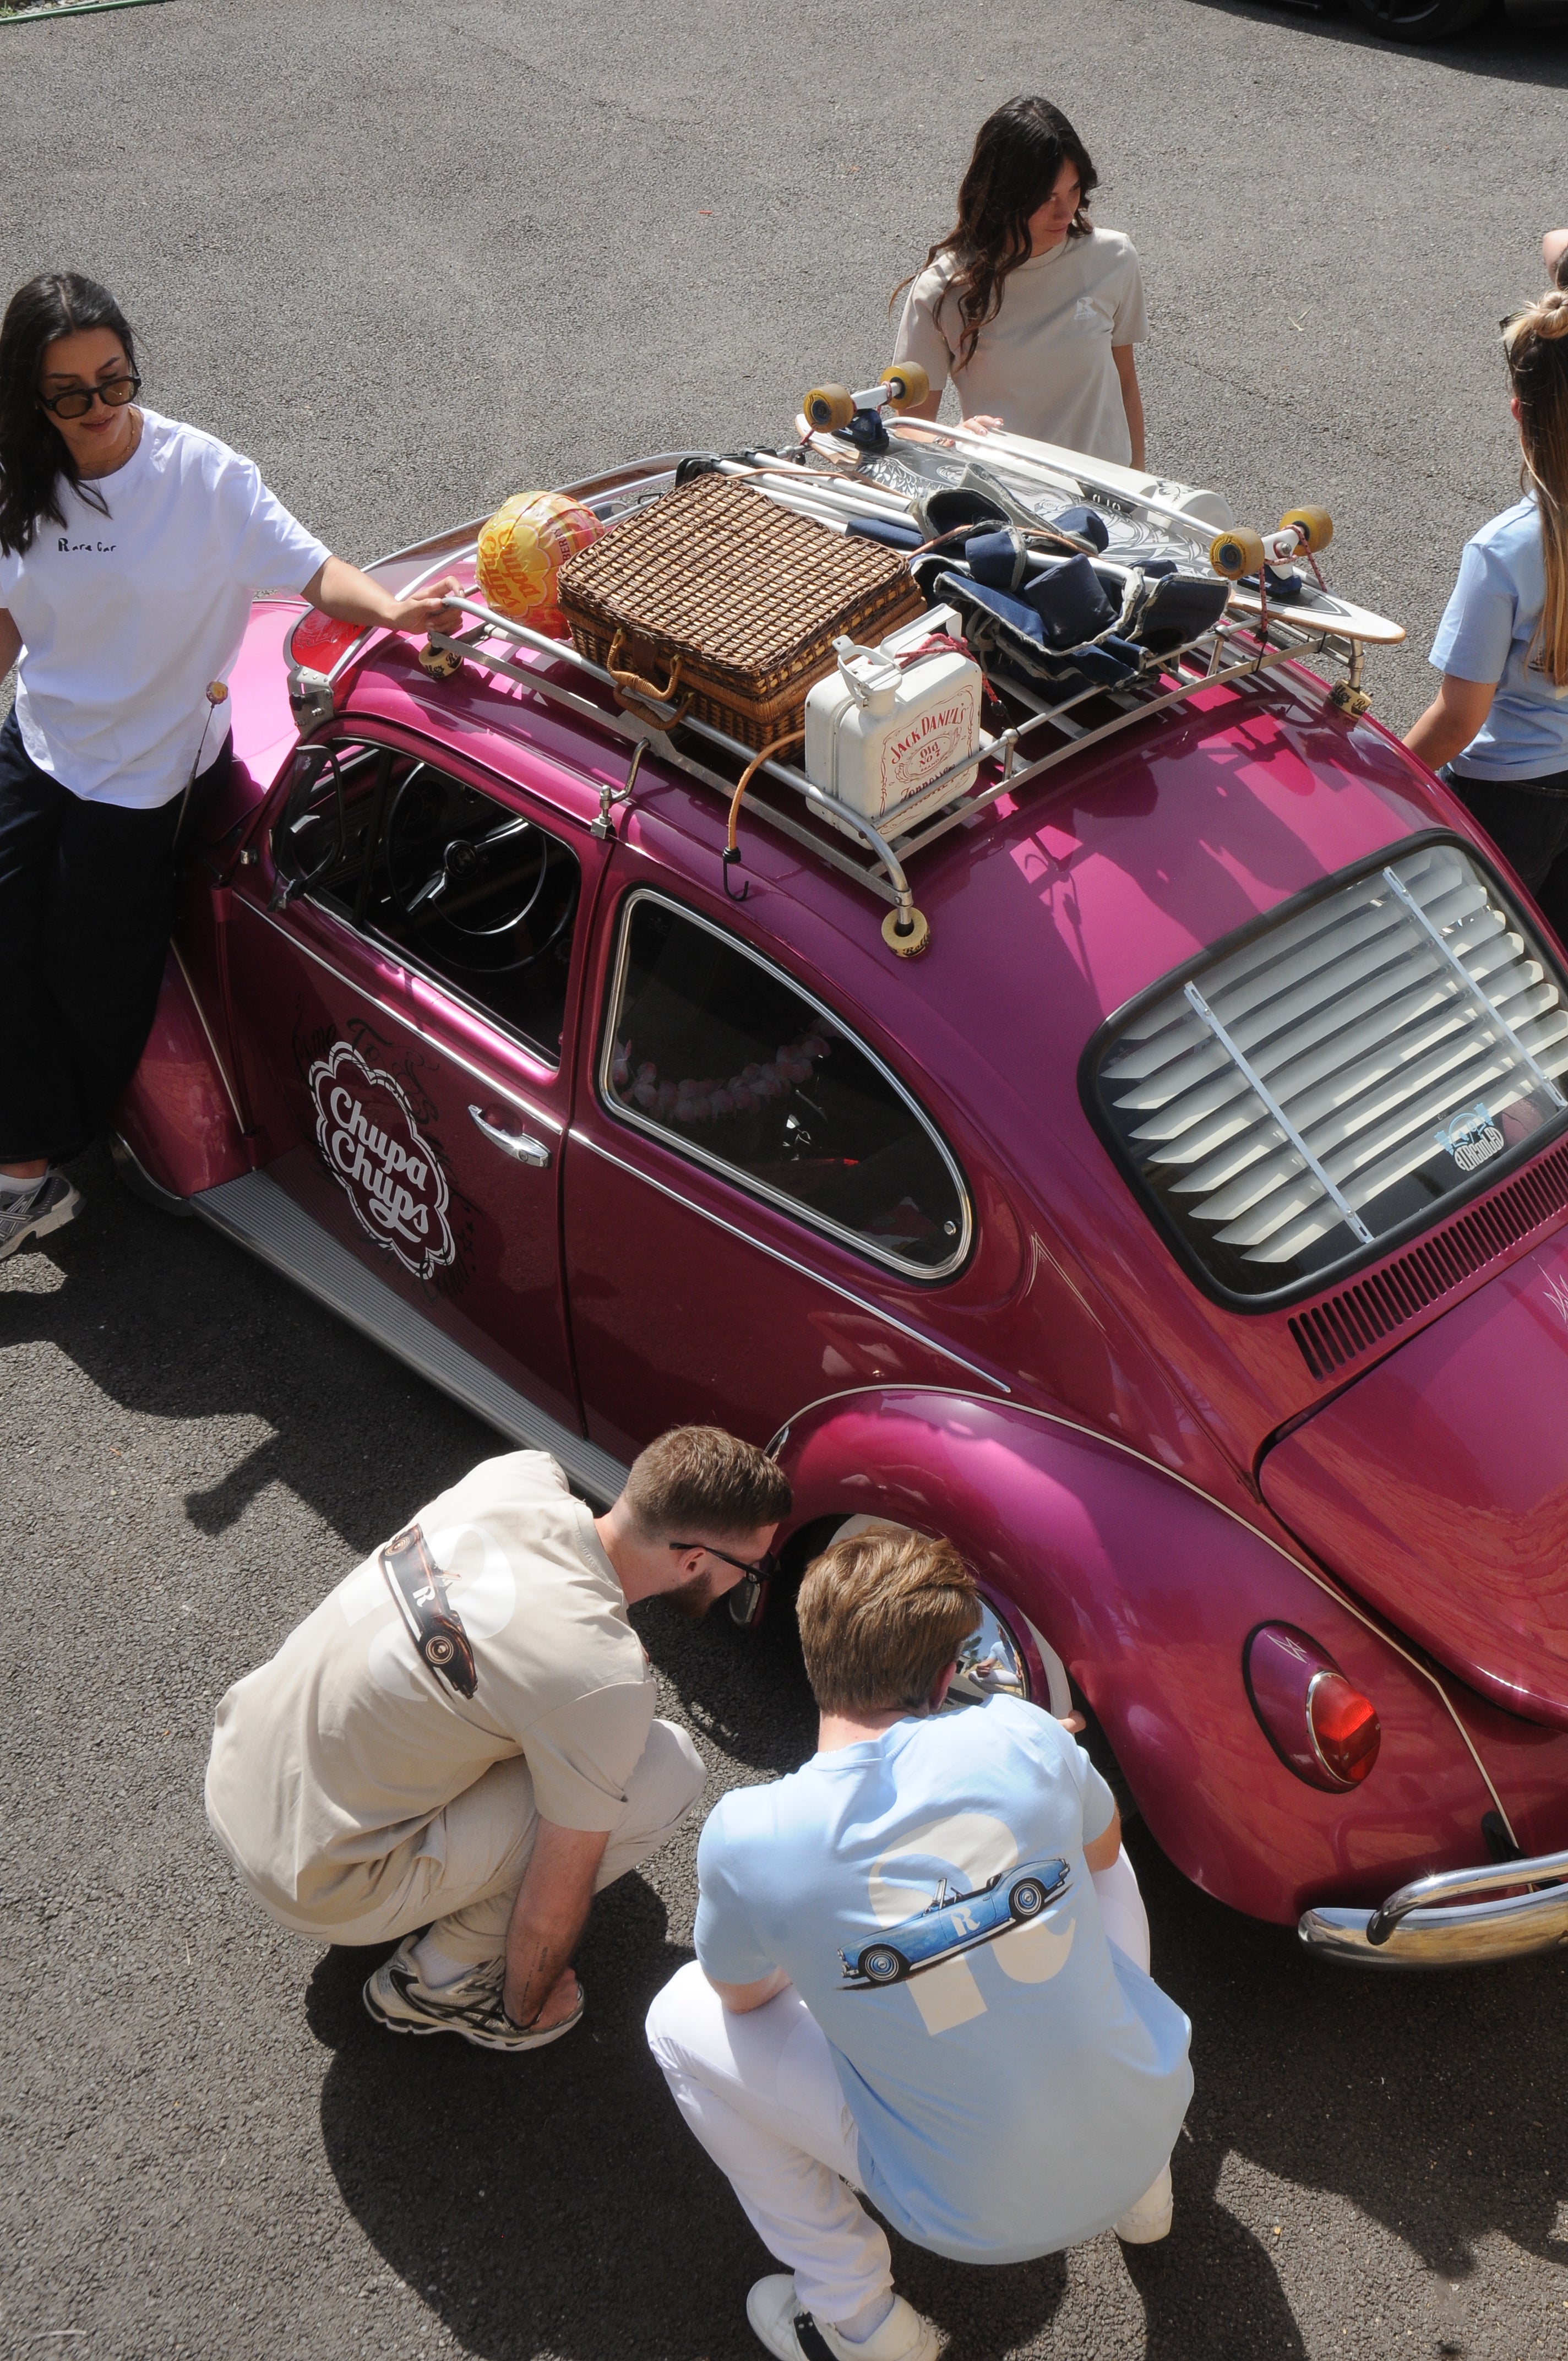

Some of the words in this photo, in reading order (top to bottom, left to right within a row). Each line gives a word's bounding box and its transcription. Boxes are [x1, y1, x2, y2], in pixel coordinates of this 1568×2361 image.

[58, 537, 92, 552] Rare
[97, 542, 117, 553] Car
[890, 727, 921, 765] JACK
[330, 1086, 428, 1191] Chupa
[331, 1130, 429, 1243] Chups
